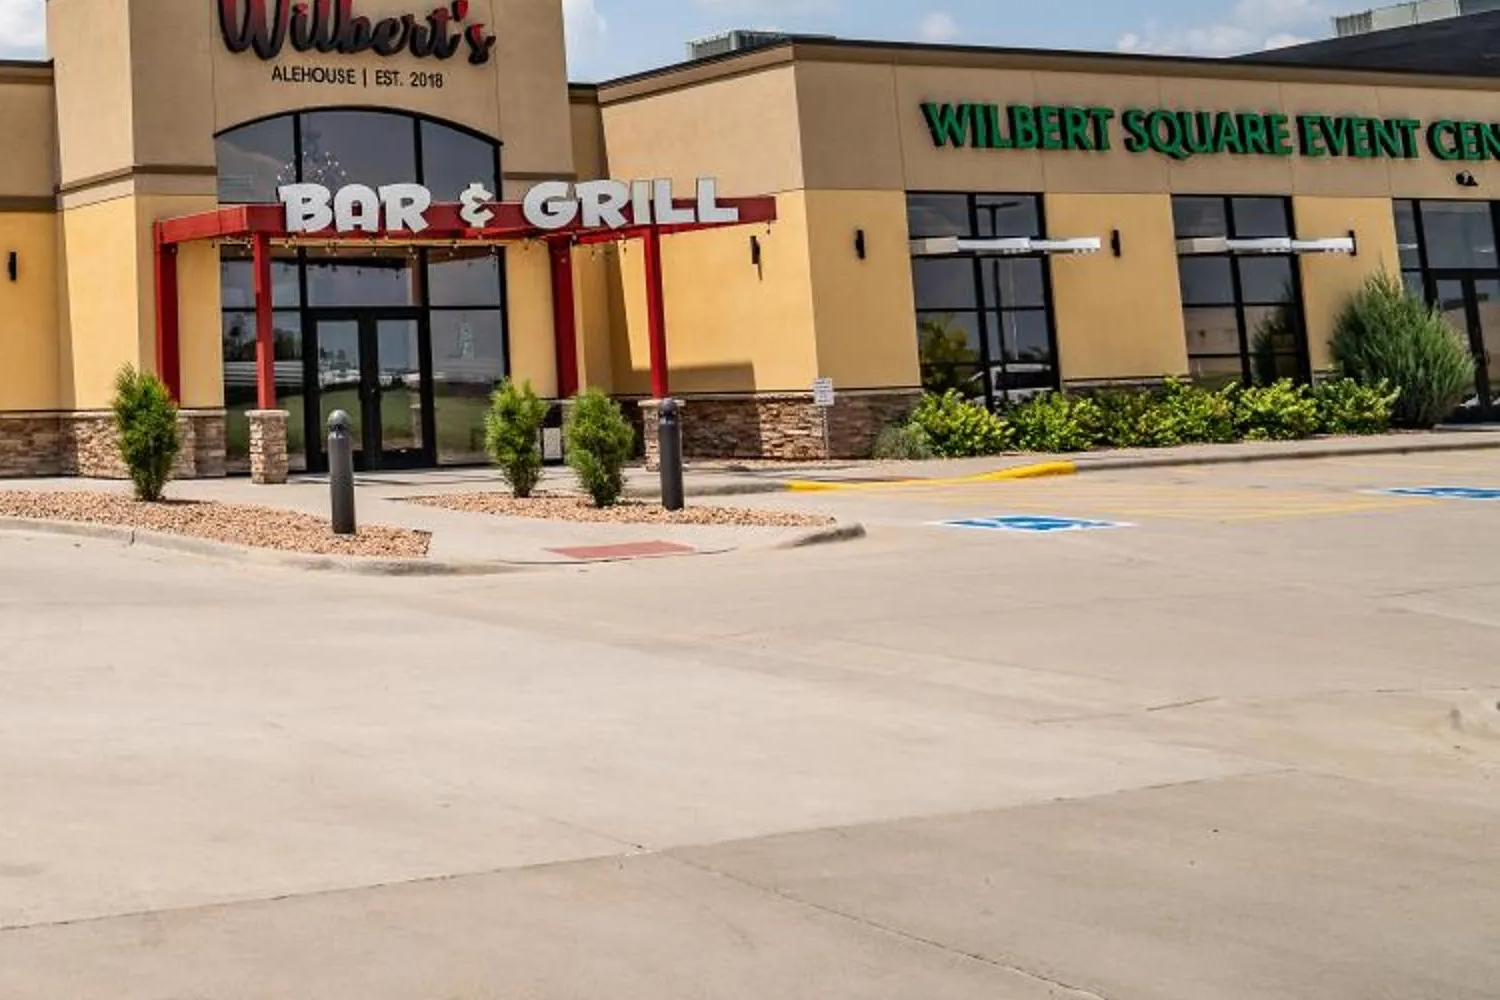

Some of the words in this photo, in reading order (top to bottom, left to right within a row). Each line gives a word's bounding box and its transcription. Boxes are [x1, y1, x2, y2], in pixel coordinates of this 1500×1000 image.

[272, 66, 357, 84] ALEHOUSE
[375, 70, 404, 87] EST.
[411, 72, 443, 88] 2018
[921, 103, 1115, 151] WILBERT
[1122, 109, 1293, 160] SQUARE
[1298, 115, 1420, 159] EVENT
[280, 183, 431, 233] BAR
[460, 183, 496, 228] &
[523, 178, 739, 230] GRILL
